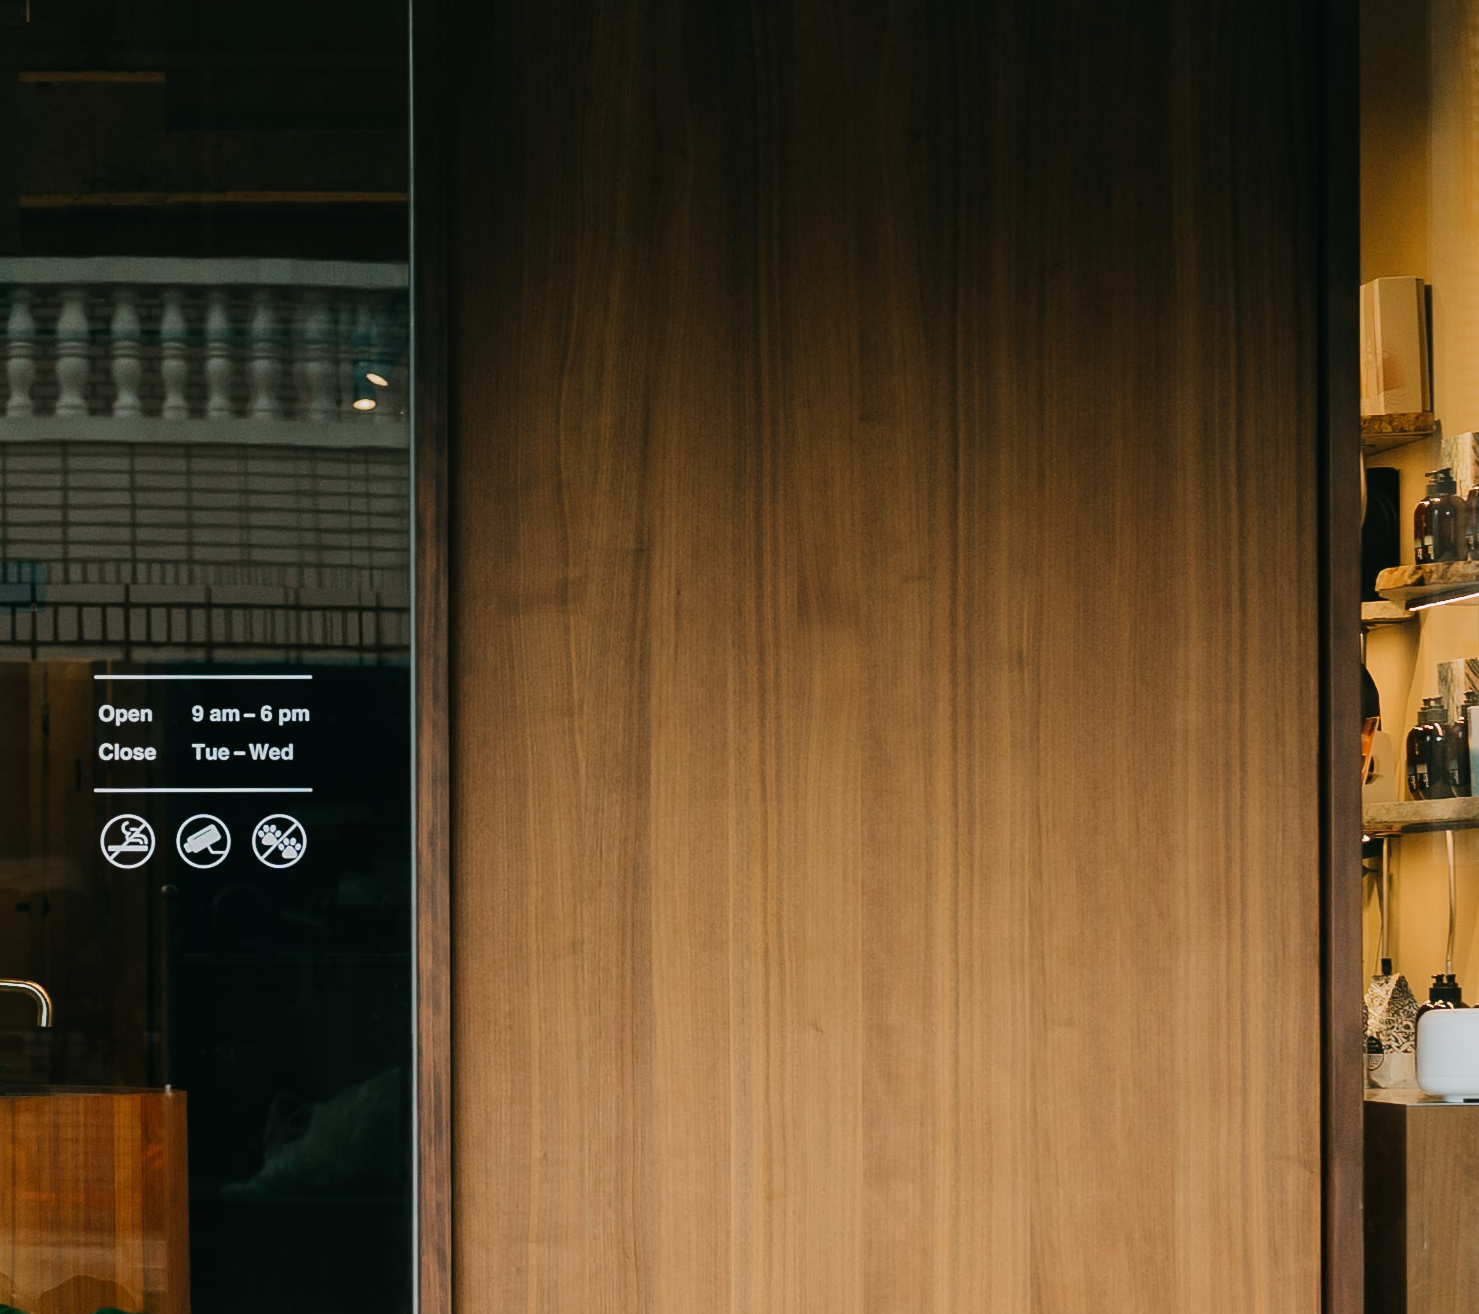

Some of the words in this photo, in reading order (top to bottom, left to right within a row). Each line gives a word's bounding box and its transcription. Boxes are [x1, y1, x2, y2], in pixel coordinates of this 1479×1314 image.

[98, 704, 153, 727] Open
[191, 705, 204, 722] 9
[209, 708, 241, 722] am
[260, 705, 273, 722] 6
[278, 708, 310, 726] pm
[98, 742, 157, 761] Close
